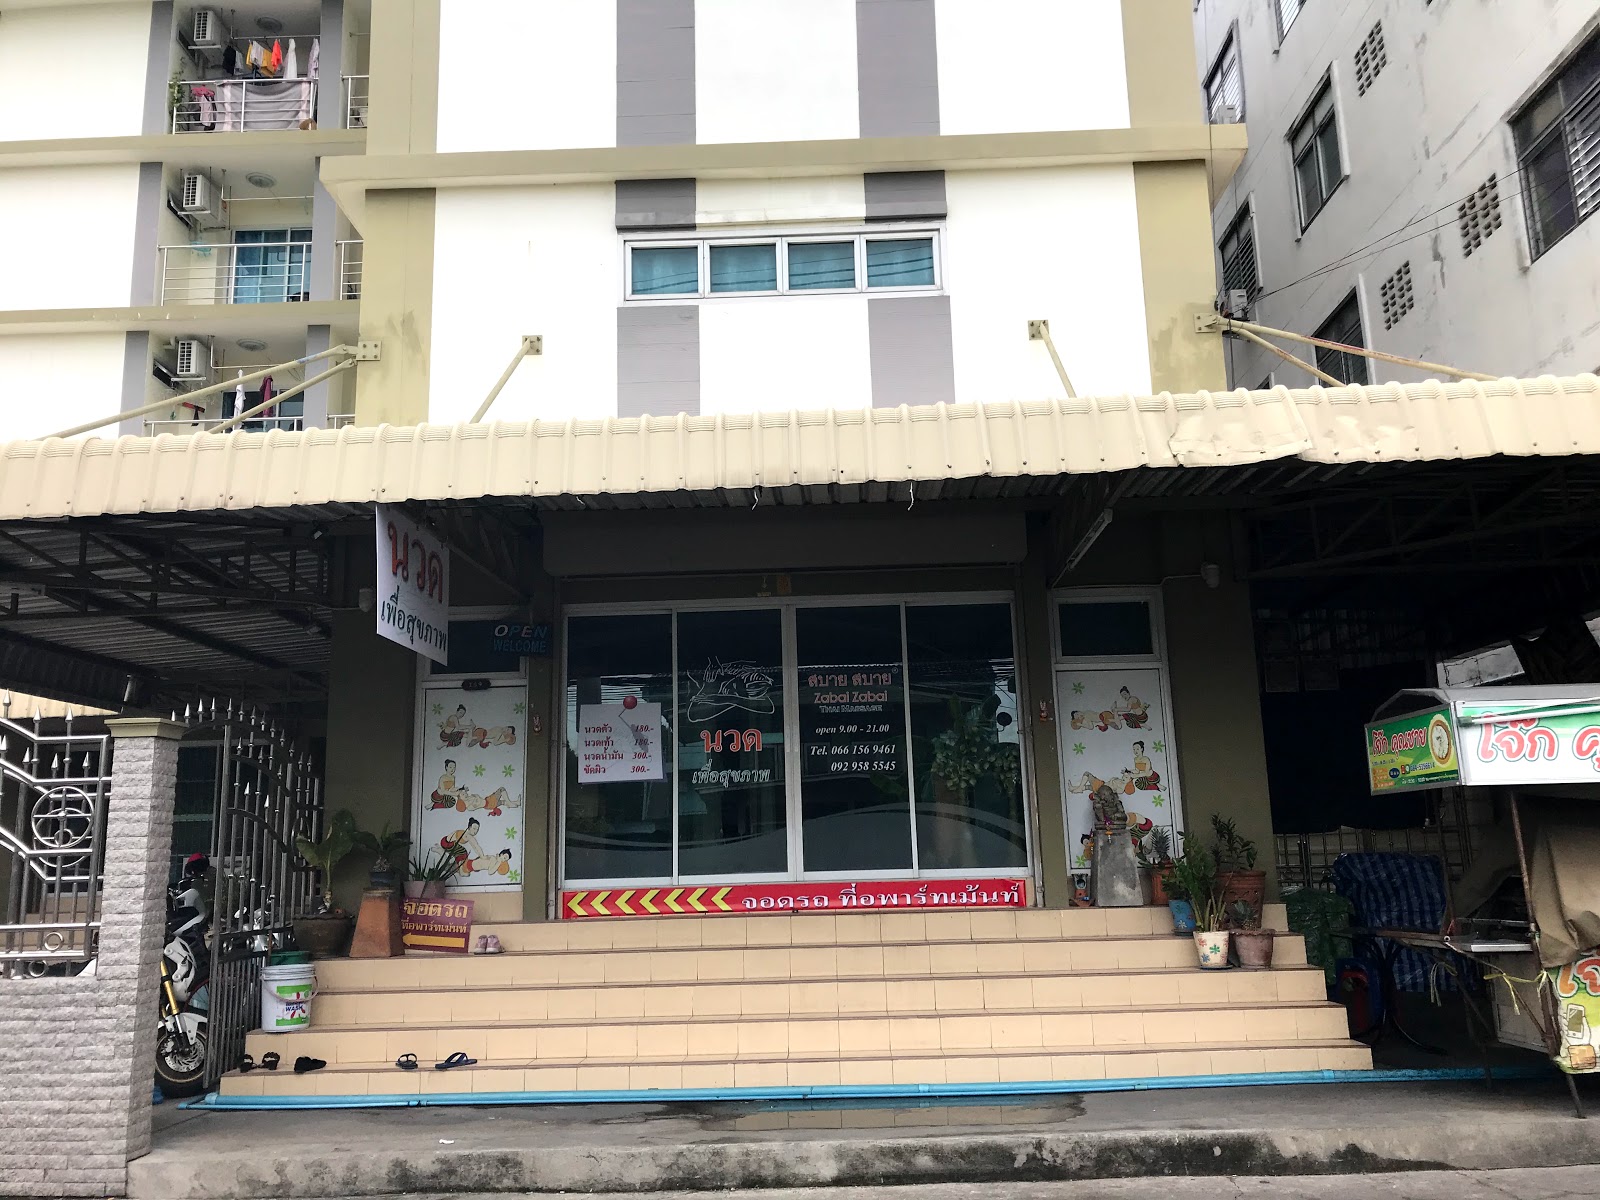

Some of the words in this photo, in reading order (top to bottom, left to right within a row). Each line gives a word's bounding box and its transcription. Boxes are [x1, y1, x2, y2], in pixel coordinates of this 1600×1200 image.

[387, 520, 444, 604] นวด
[380, 586, 448, 652] เพื่อสุขภาพ
[494, 624, 548, 639] OPEN
[493, 639, 546, 653] WELCOME
[807, 673, 848, 688] สบาย
[851, 672, 892, 686] สบาย
[814, 691, 850, 704] Zabai
[852, 690, 888, 703] Zabai
[819, 705, 840, 713] THAI
[841, 704, 883, 713] MASSAGE
[584, 723, 612, 734] นวดตัว
[815, 726, 836, 735] open
[838, 725, 857, 733] 9.00
[866, 724, 890, 733] 21.00
[584, 736, 614, 747] นวดเท้า
[700, 728, 763, 753] นวด
[1372, 729, 1389, 756] โจ๊ก
[1391, 726, 1428, 759] คุณชาย
[1478, 712, 1559, 762] โจ๊ก
[583, 747, 624, 761] นวดน้ำมัน
[632, 752, 652, 760] 300.-
[810, 746, 828, 755] Tel.
[831, 745, 849, 755] 066
[852, 745, 869, 755] 156
[872, 744, 896, 754] 9461
[630, 765, 650, 773] 300.-
[691, 759, 770, 788] เพื่อสุขภาพ
[831, 762, 848, 772] 092
[851, 761, 869, 771] 958
[872, 761, 896, 771] 5545
[741, 892, 829, 910] จอดรถ
[839, 882, 1020, 907] ที่อพาร์ทเม้นท์
